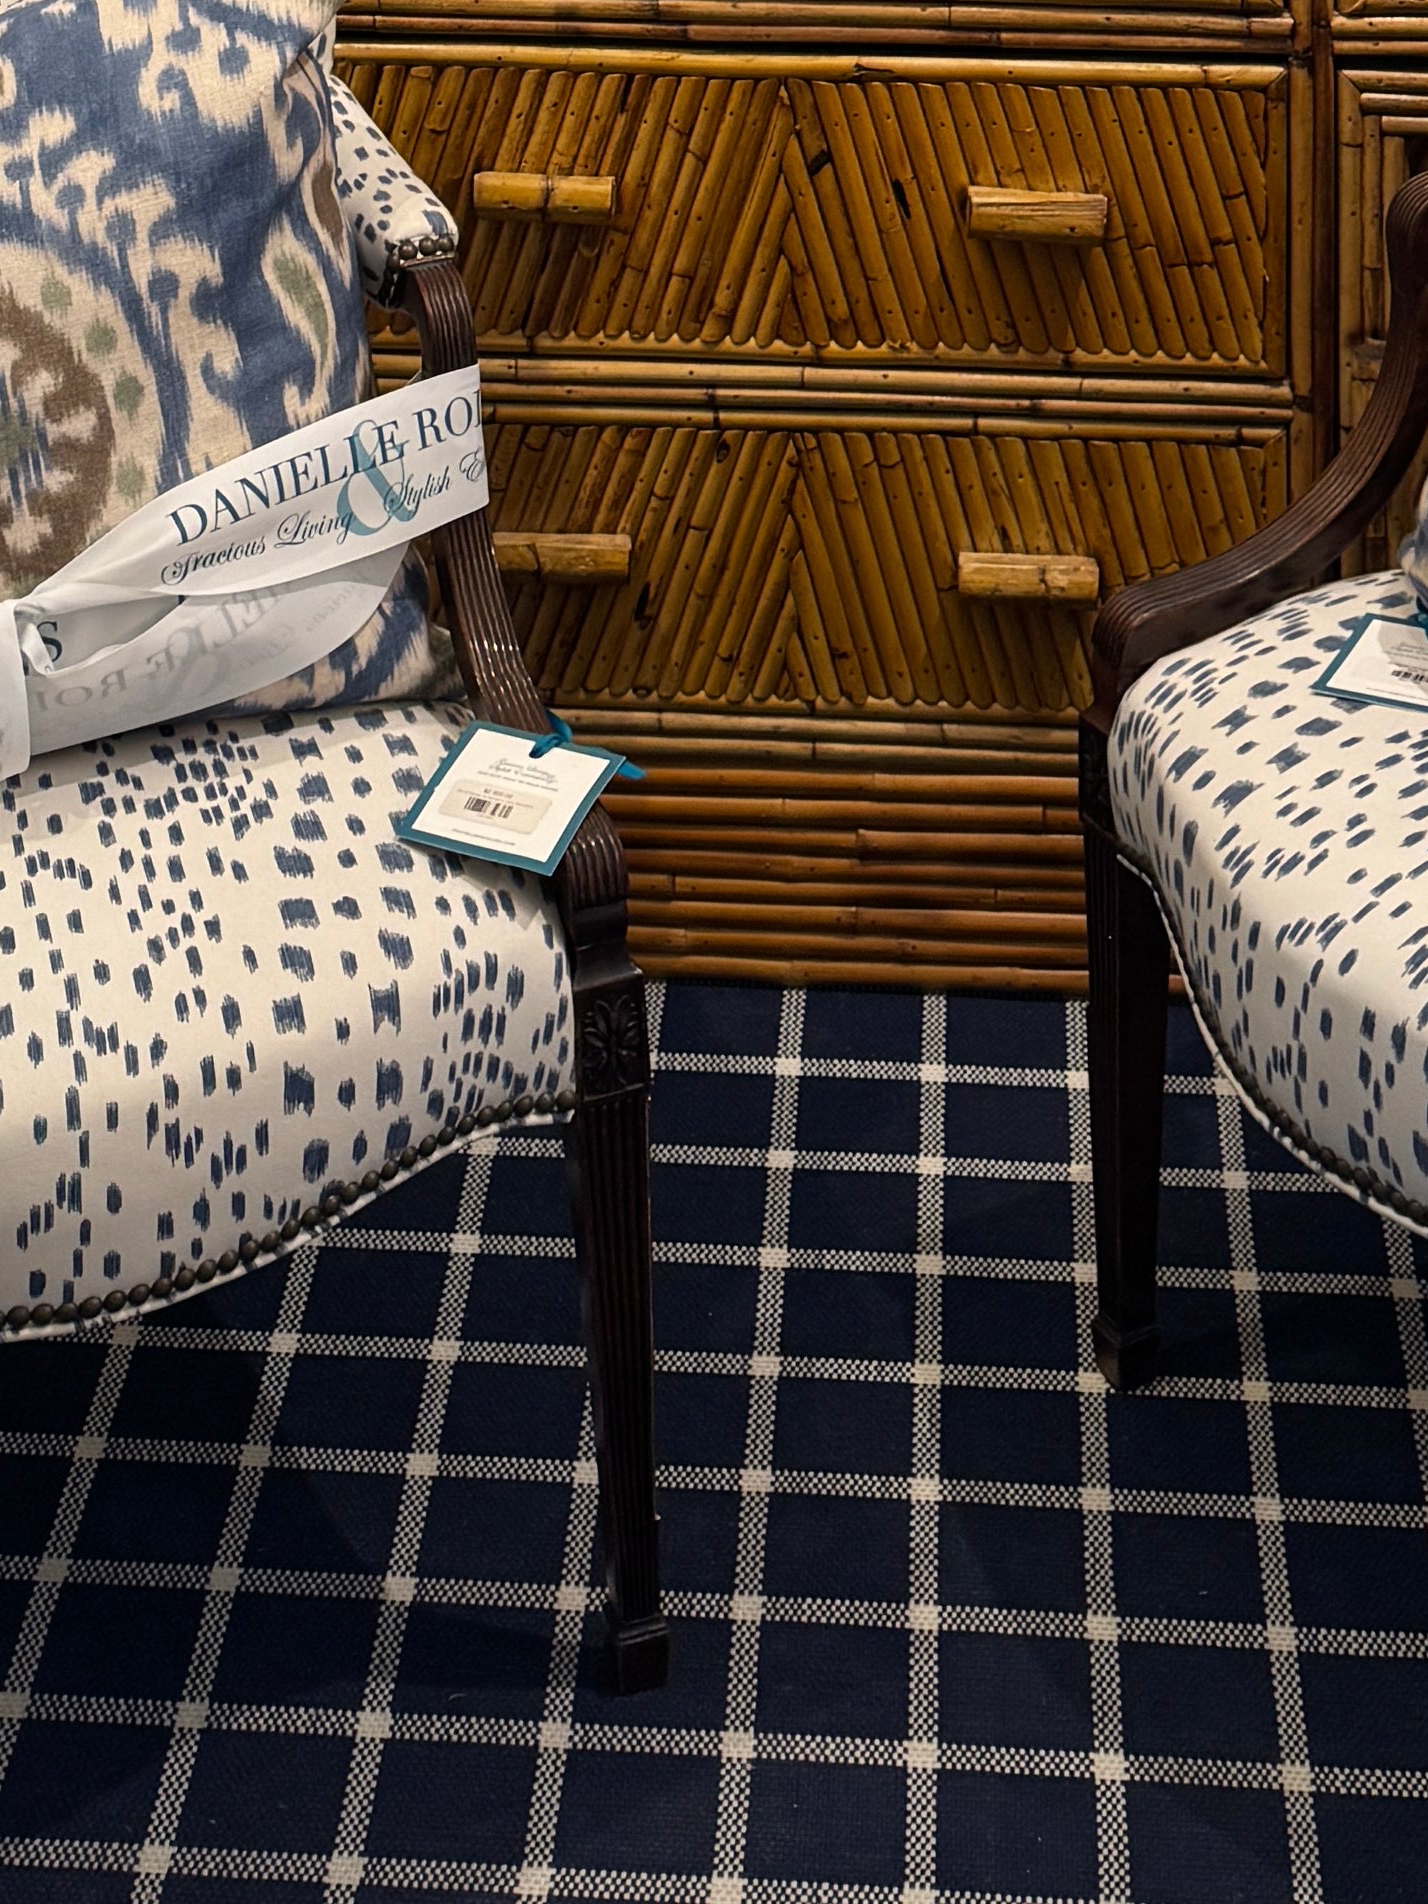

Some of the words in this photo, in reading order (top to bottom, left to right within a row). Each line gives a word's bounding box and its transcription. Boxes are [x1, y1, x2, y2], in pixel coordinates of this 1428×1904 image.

[166, 419, 406, 547] DANIELLE
[274, 509, 356, 545] Living
[384, 465, 453, 515] Stylish
